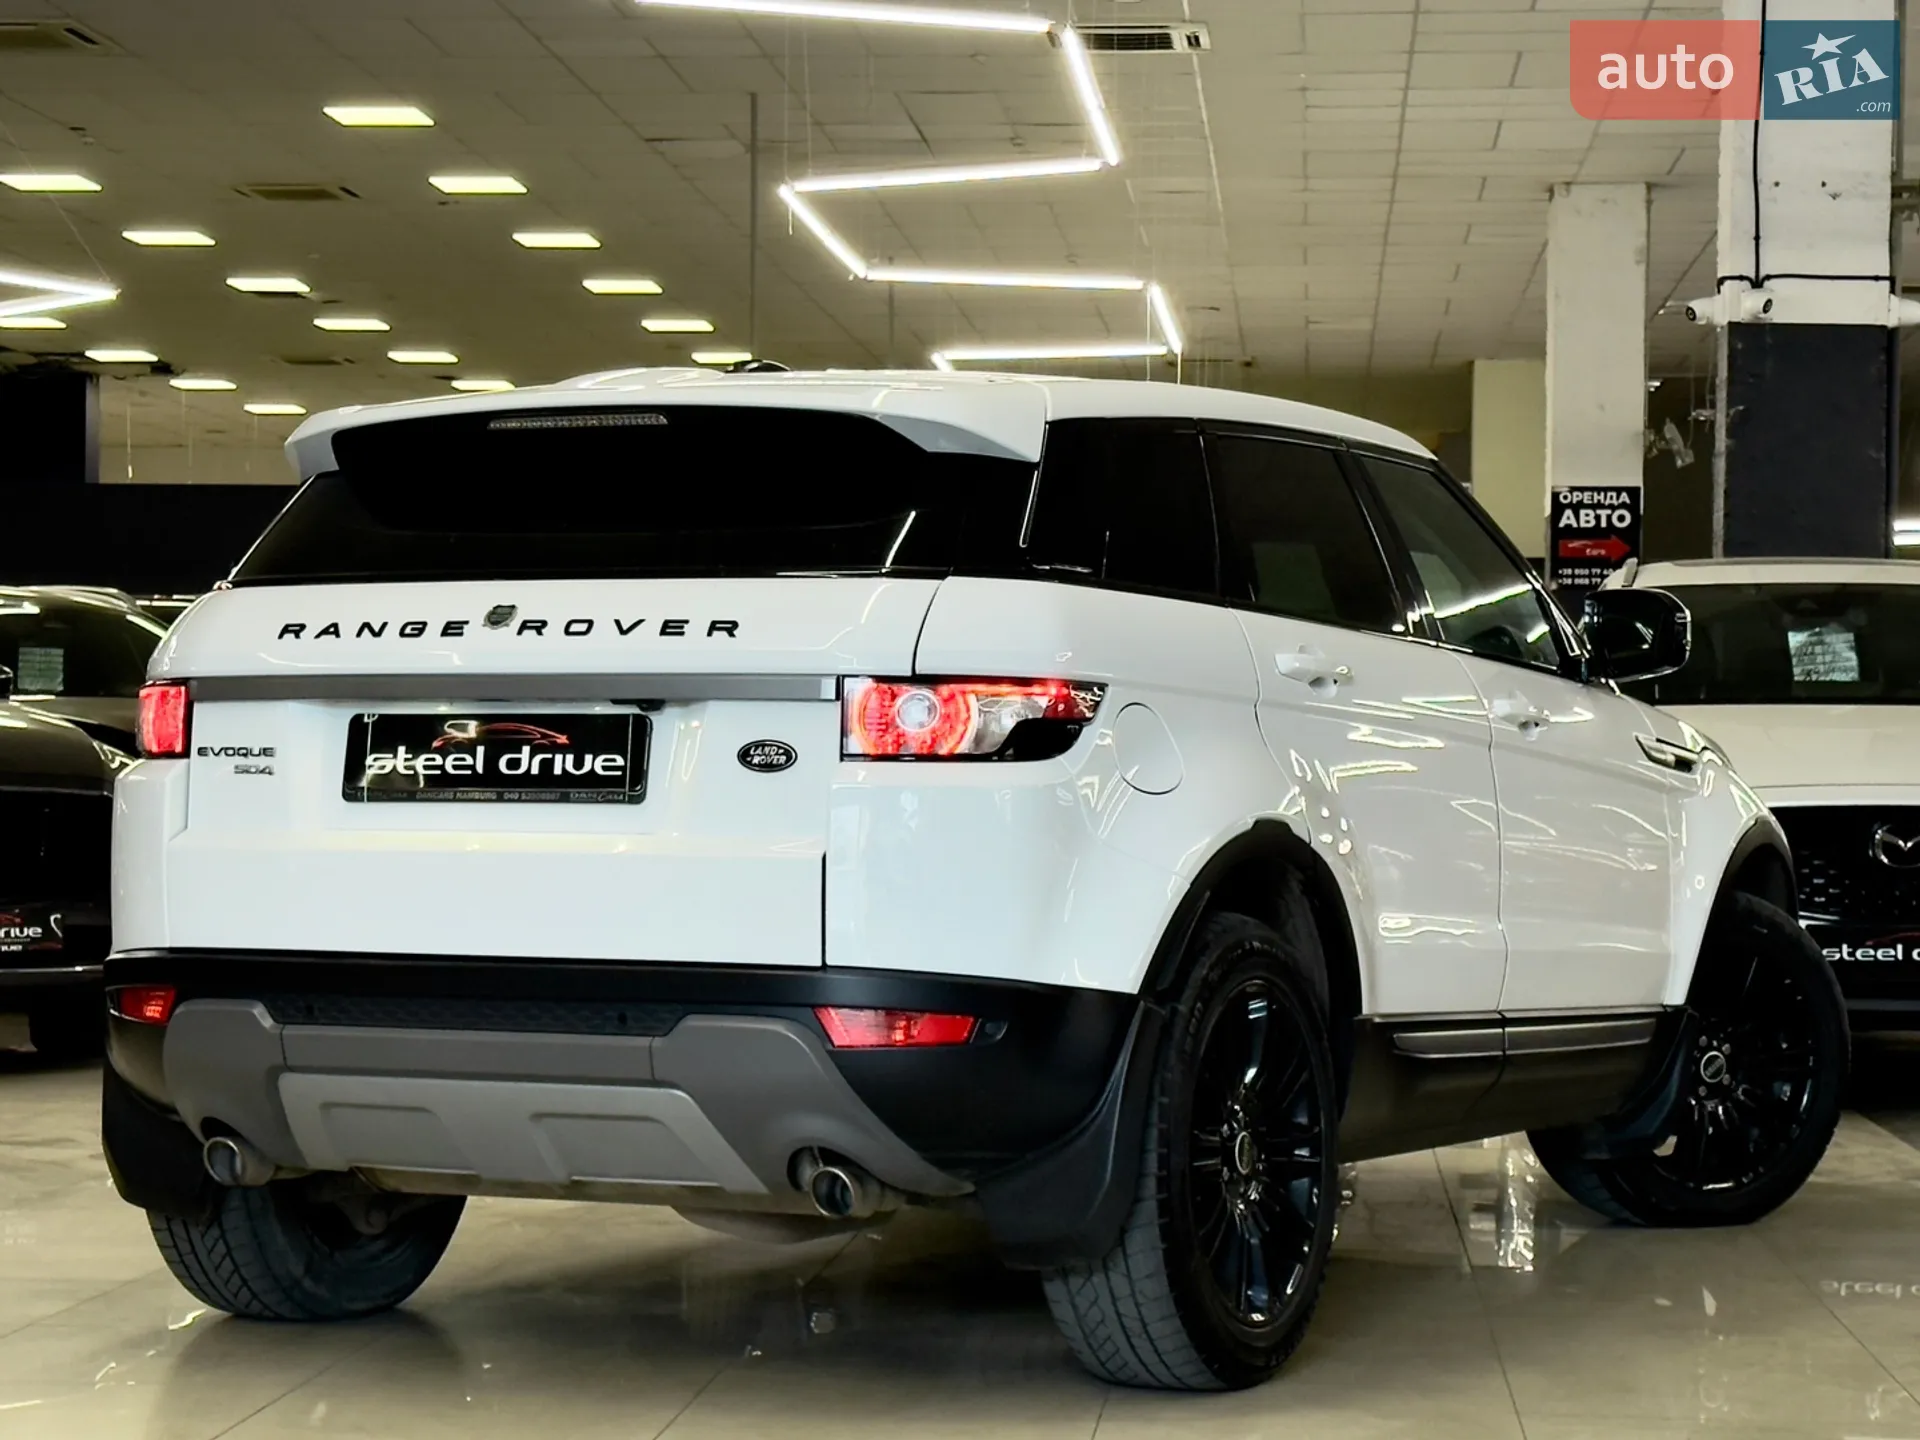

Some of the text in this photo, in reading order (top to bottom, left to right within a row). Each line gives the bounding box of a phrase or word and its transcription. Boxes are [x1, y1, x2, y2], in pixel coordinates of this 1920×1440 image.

[1559, 491, 1631, 506] ОРЕНДА
[1558, 508, 1632, 528] АВТО
[277, 618, 741, 640] RANGE ROVER
[197, 746, 276, 758] EVOQUE
[365, 745, 625, 776] steel drive
[0, 926, 43, 939] rive
[1821, 942, 1904, 962] steel
